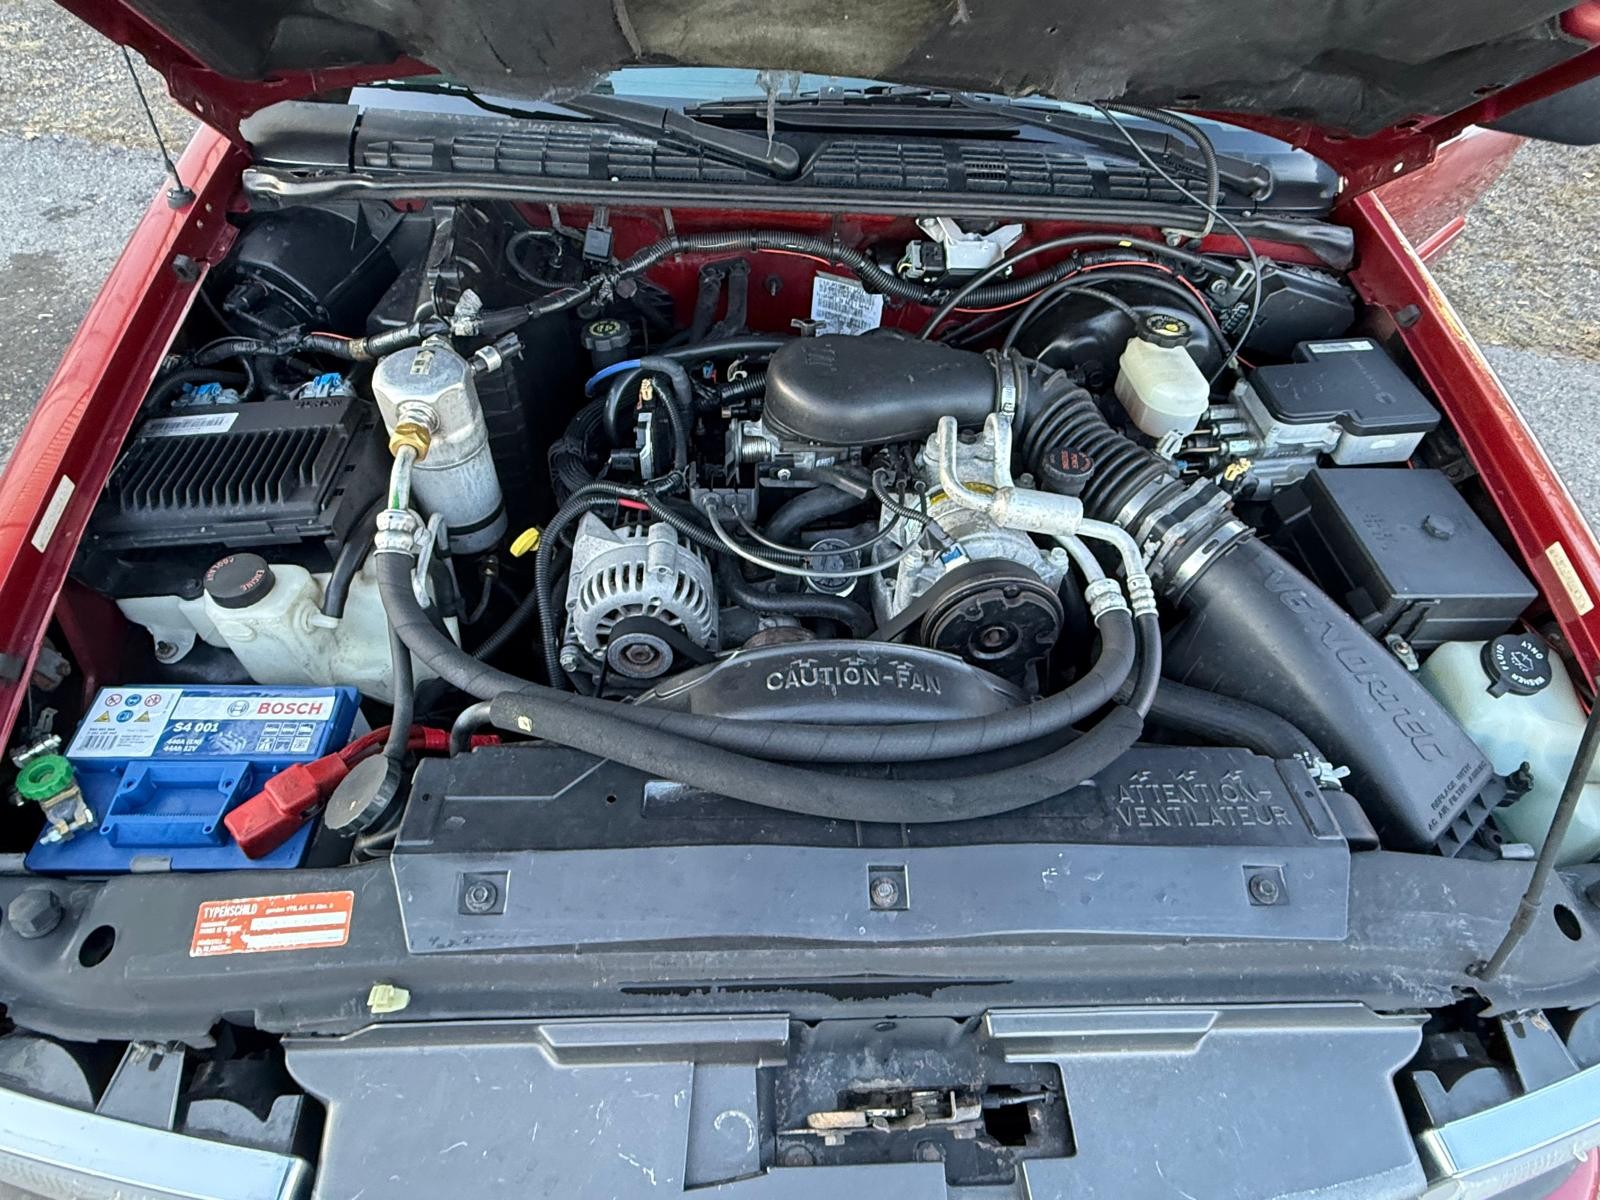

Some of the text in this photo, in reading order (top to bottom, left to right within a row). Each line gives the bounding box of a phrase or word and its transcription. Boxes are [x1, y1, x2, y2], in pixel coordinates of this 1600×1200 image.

[207, 556, 265, 592] ENGINE COOLANT
[1496, 640, 1545, 686] WASHER FLUID ONLY
[257, 702, 323, 715] BOSCH
[173, 722, 219, 733] S4 001
[1431, 780, 1457, 810] REPLACE
[1448, 782, 1469, 806] FILTER
[1116, 806, 1293, 827] VENTILATEUR
[203, 903, 258, 919] TYPENSCHILD
